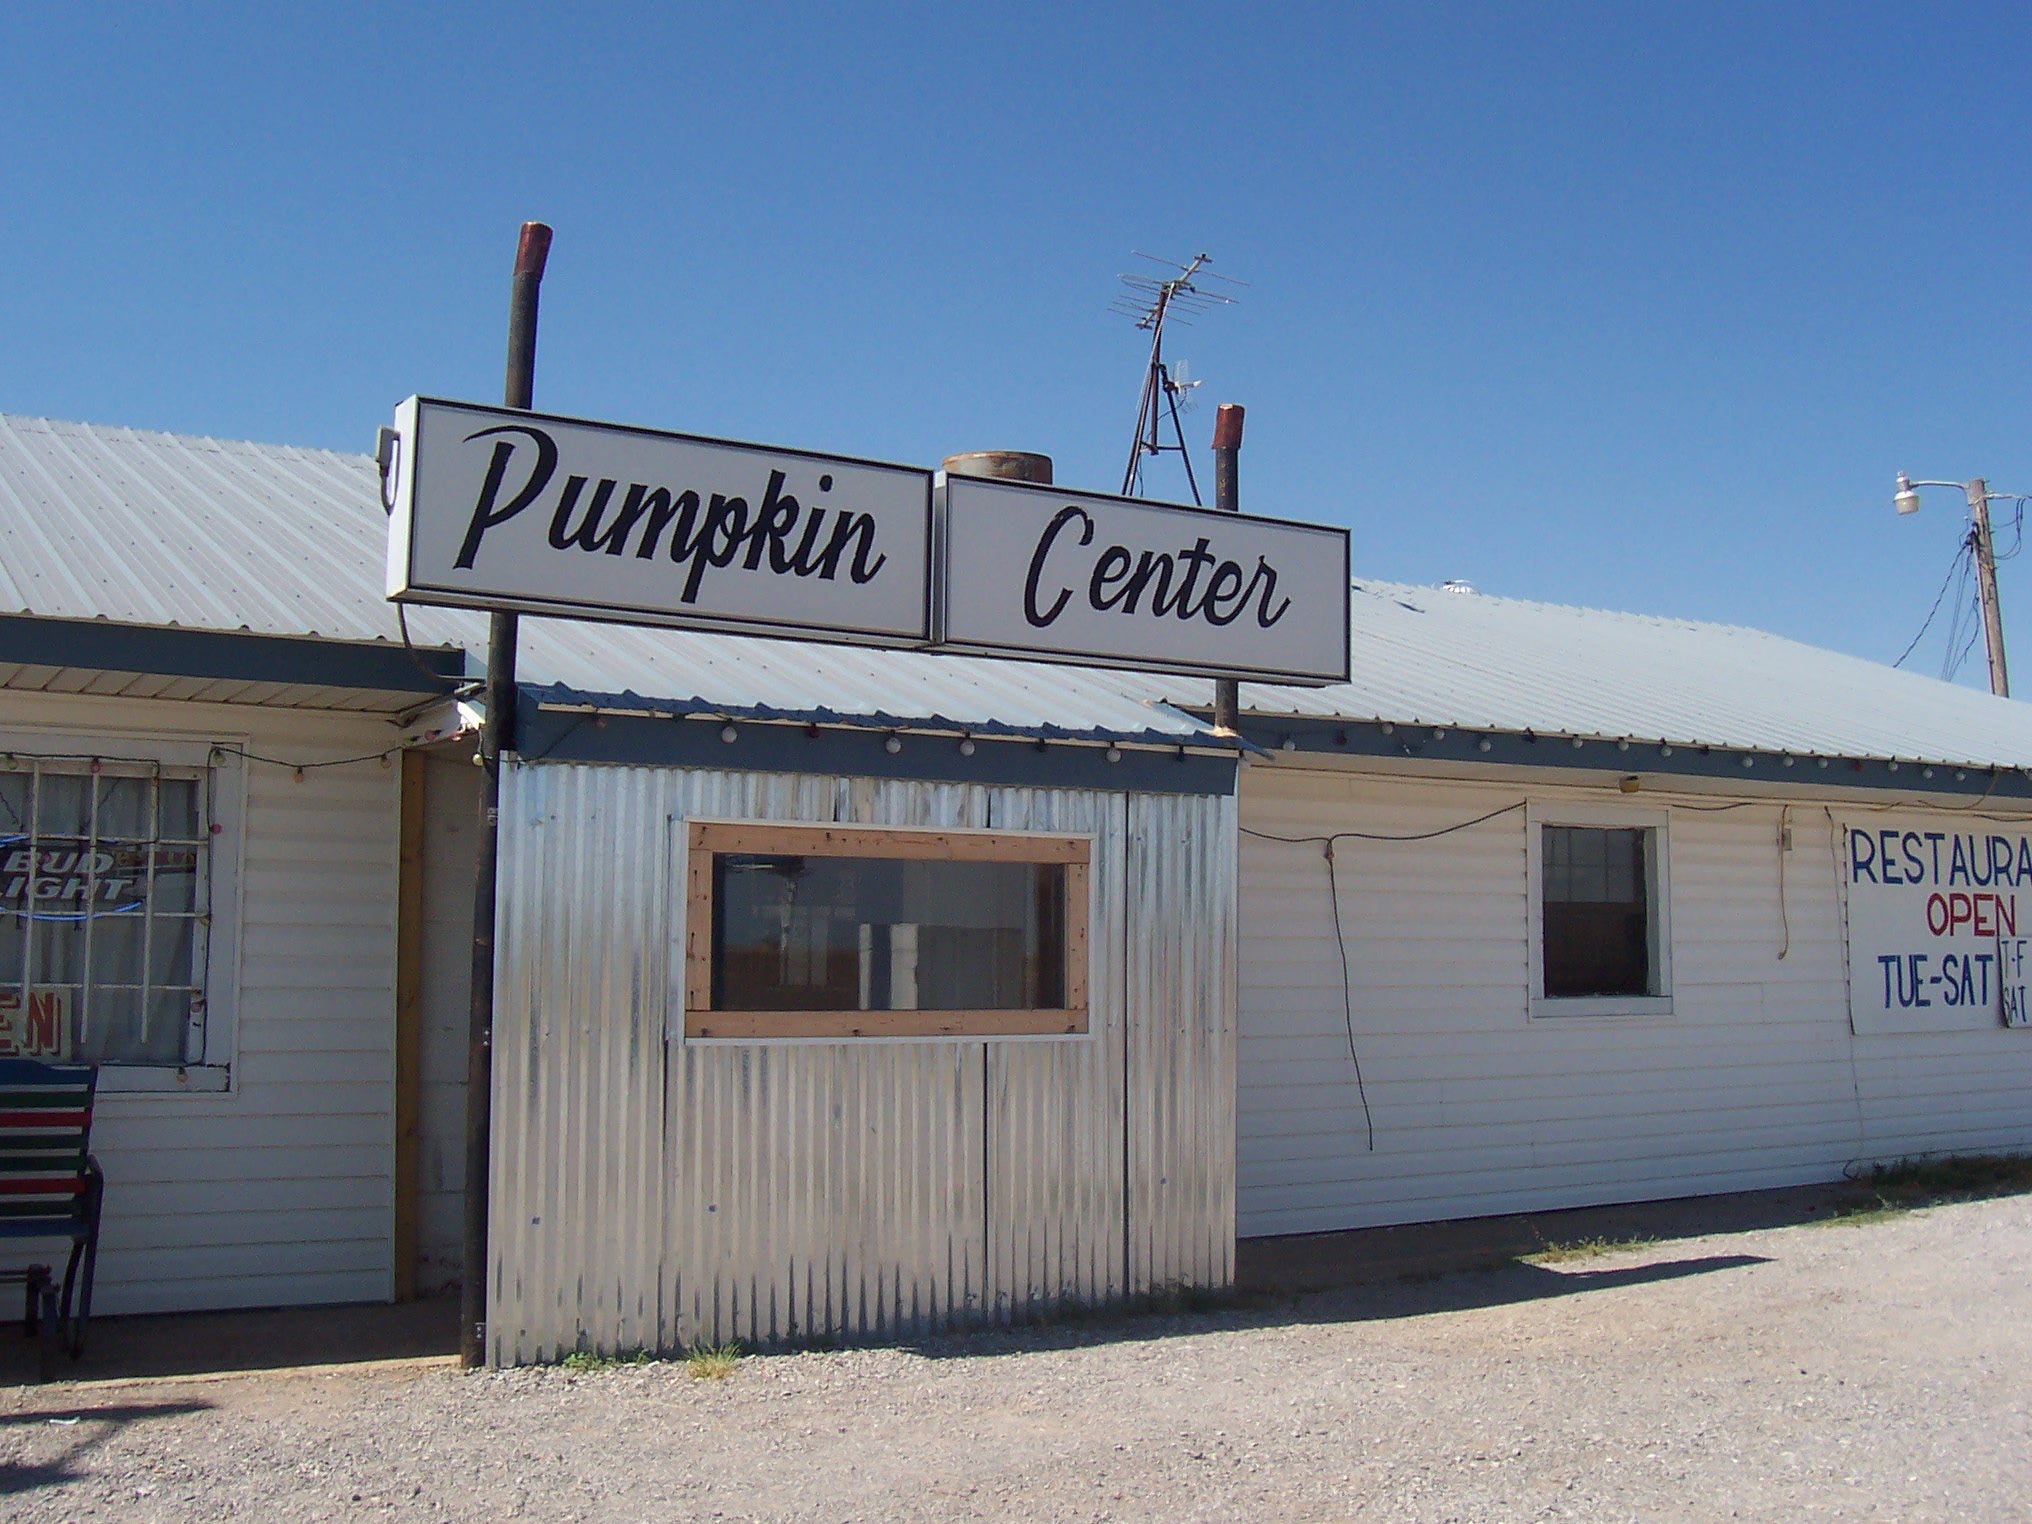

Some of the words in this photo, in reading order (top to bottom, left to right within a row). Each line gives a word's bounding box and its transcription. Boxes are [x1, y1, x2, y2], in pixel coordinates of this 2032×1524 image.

[453, 425, 887, 604] Pumpkin
[1024, 506, 1291, 629] Center
[3, 852, 113, 873] BUD
[1851, 829, 2032, 886] RESTAURA
[0, 877, 133, 899] IGHT
[1926, 893, 2015, 936] OPEN
[1878, 954, 1994, 1008] TUE-SAT
